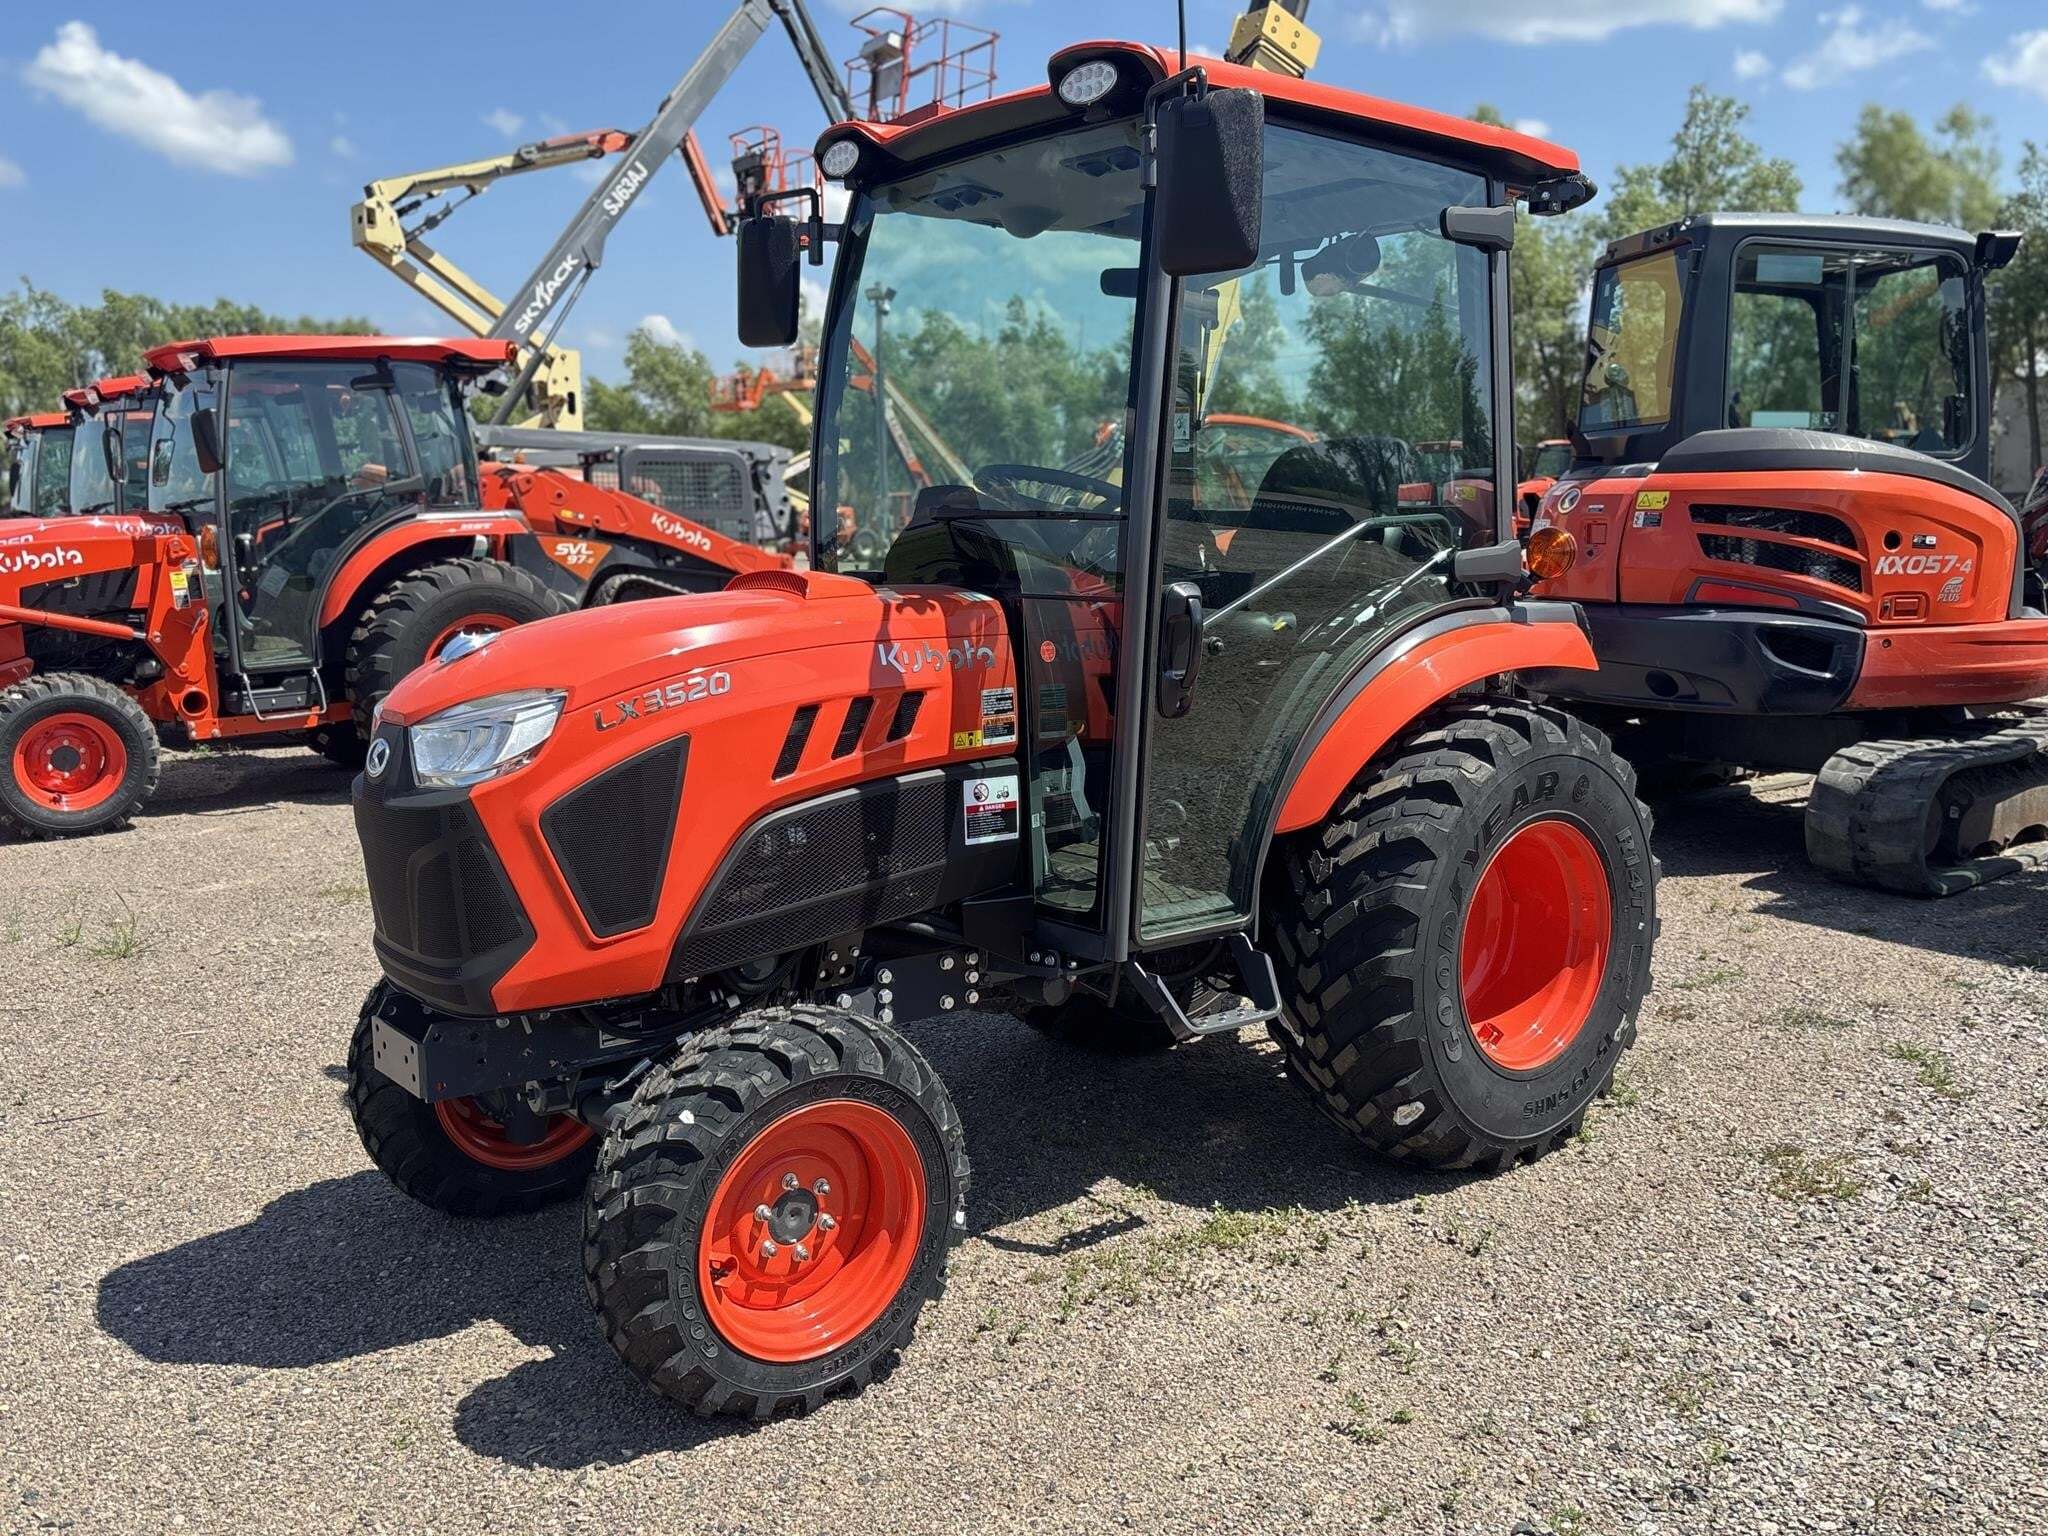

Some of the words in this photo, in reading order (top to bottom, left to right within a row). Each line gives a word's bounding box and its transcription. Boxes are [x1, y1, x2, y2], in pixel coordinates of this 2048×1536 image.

[603, 161, 649, 216] SJ63AJ
[514, 253, 579, 334] SKYJACK
[554, 542, 594, 556] SVL
[652, 512, 711, 551] Kubota
[1874, 554, 1973, 575] KX057-4
[1937, 592, 1961, 602] PLUS
[878, 639, 996, 673] Kubota
[593, 671, 731, 732] LX3520
[1434, 770, 1561, 1064] GOODYEAR
